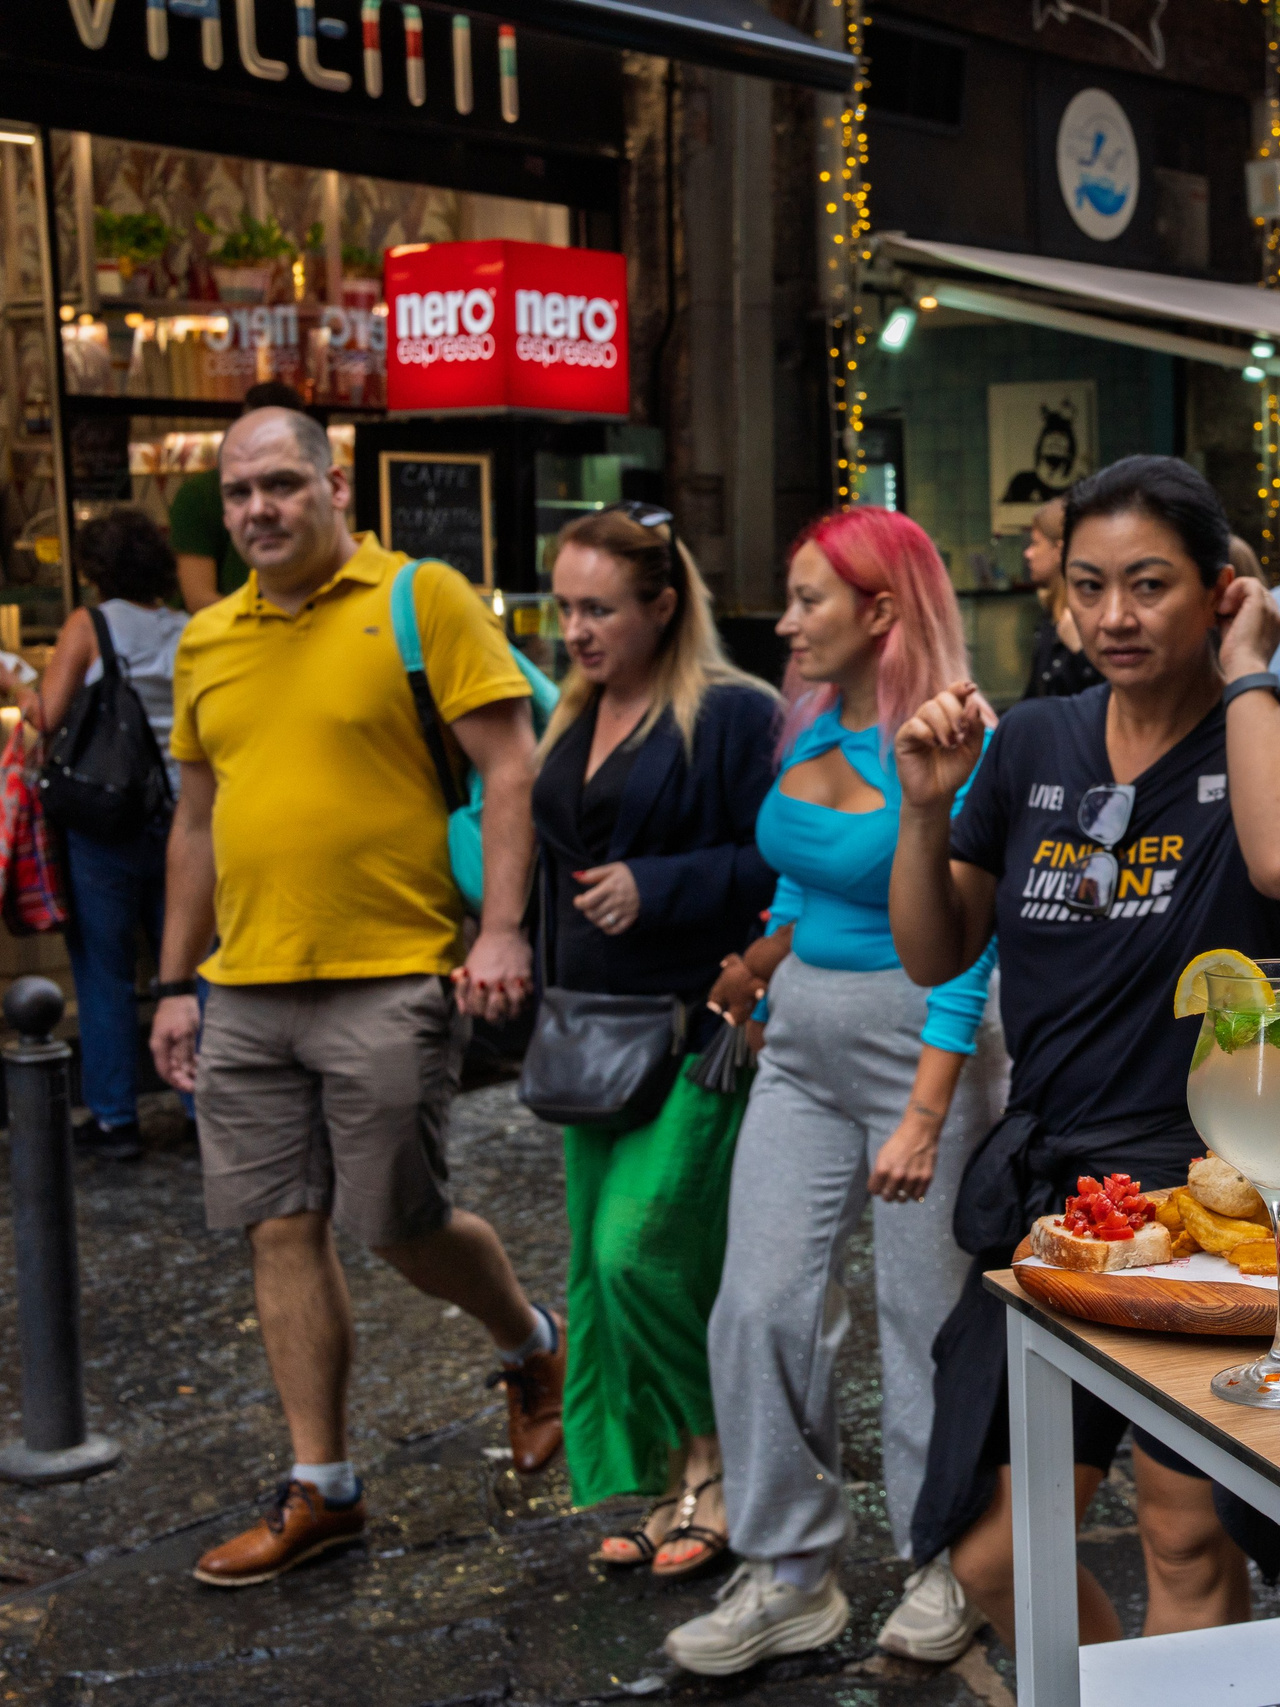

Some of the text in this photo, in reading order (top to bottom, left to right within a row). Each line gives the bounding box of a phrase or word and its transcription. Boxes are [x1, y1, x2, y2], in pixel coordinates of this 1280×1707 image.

[395, 287, 495, 339] nero
[515, 289, 617, 343] nero
[397, 333, 496, 369] espresso
[515, 334, 618, 369] espresso
[1028, 782, 1065, 811] LIVE!
